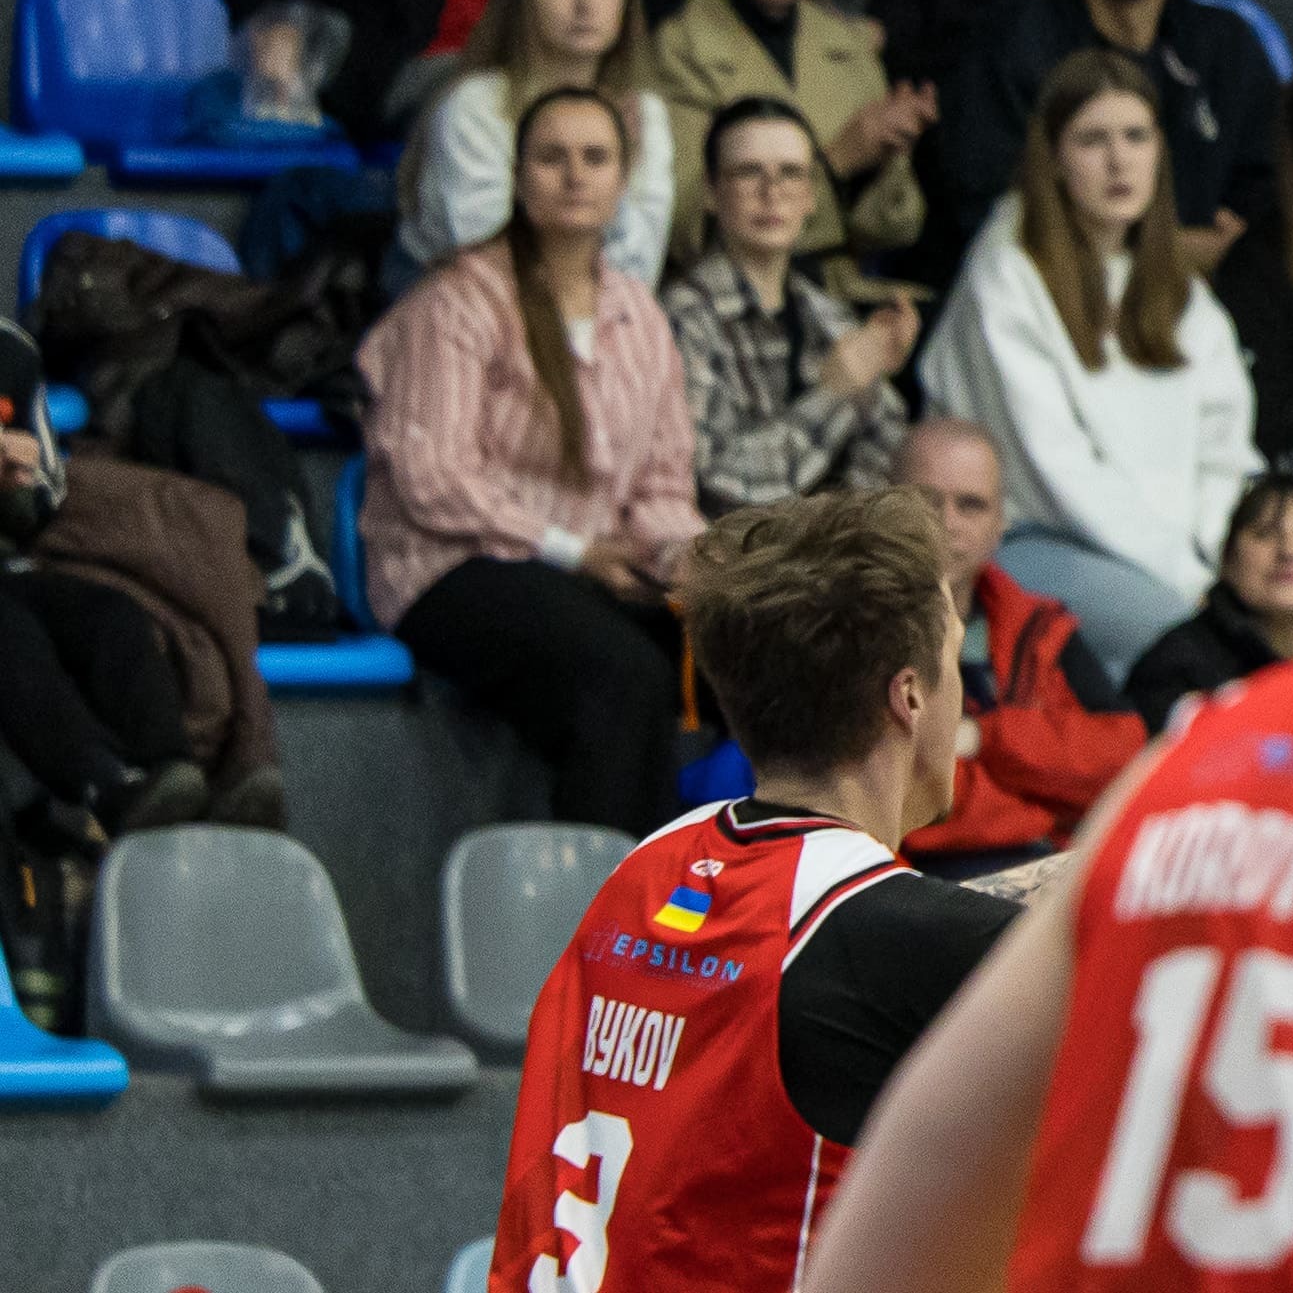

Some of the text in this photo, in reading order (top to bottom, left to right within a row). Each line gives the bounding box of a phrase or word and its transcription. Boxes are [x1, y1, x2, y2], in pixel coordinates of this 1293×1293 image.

[612, 933, 744, 981] EPSILON
[581, 995, 685, 1091] BYKOV
[527, 1110, 634, 1293] 3
